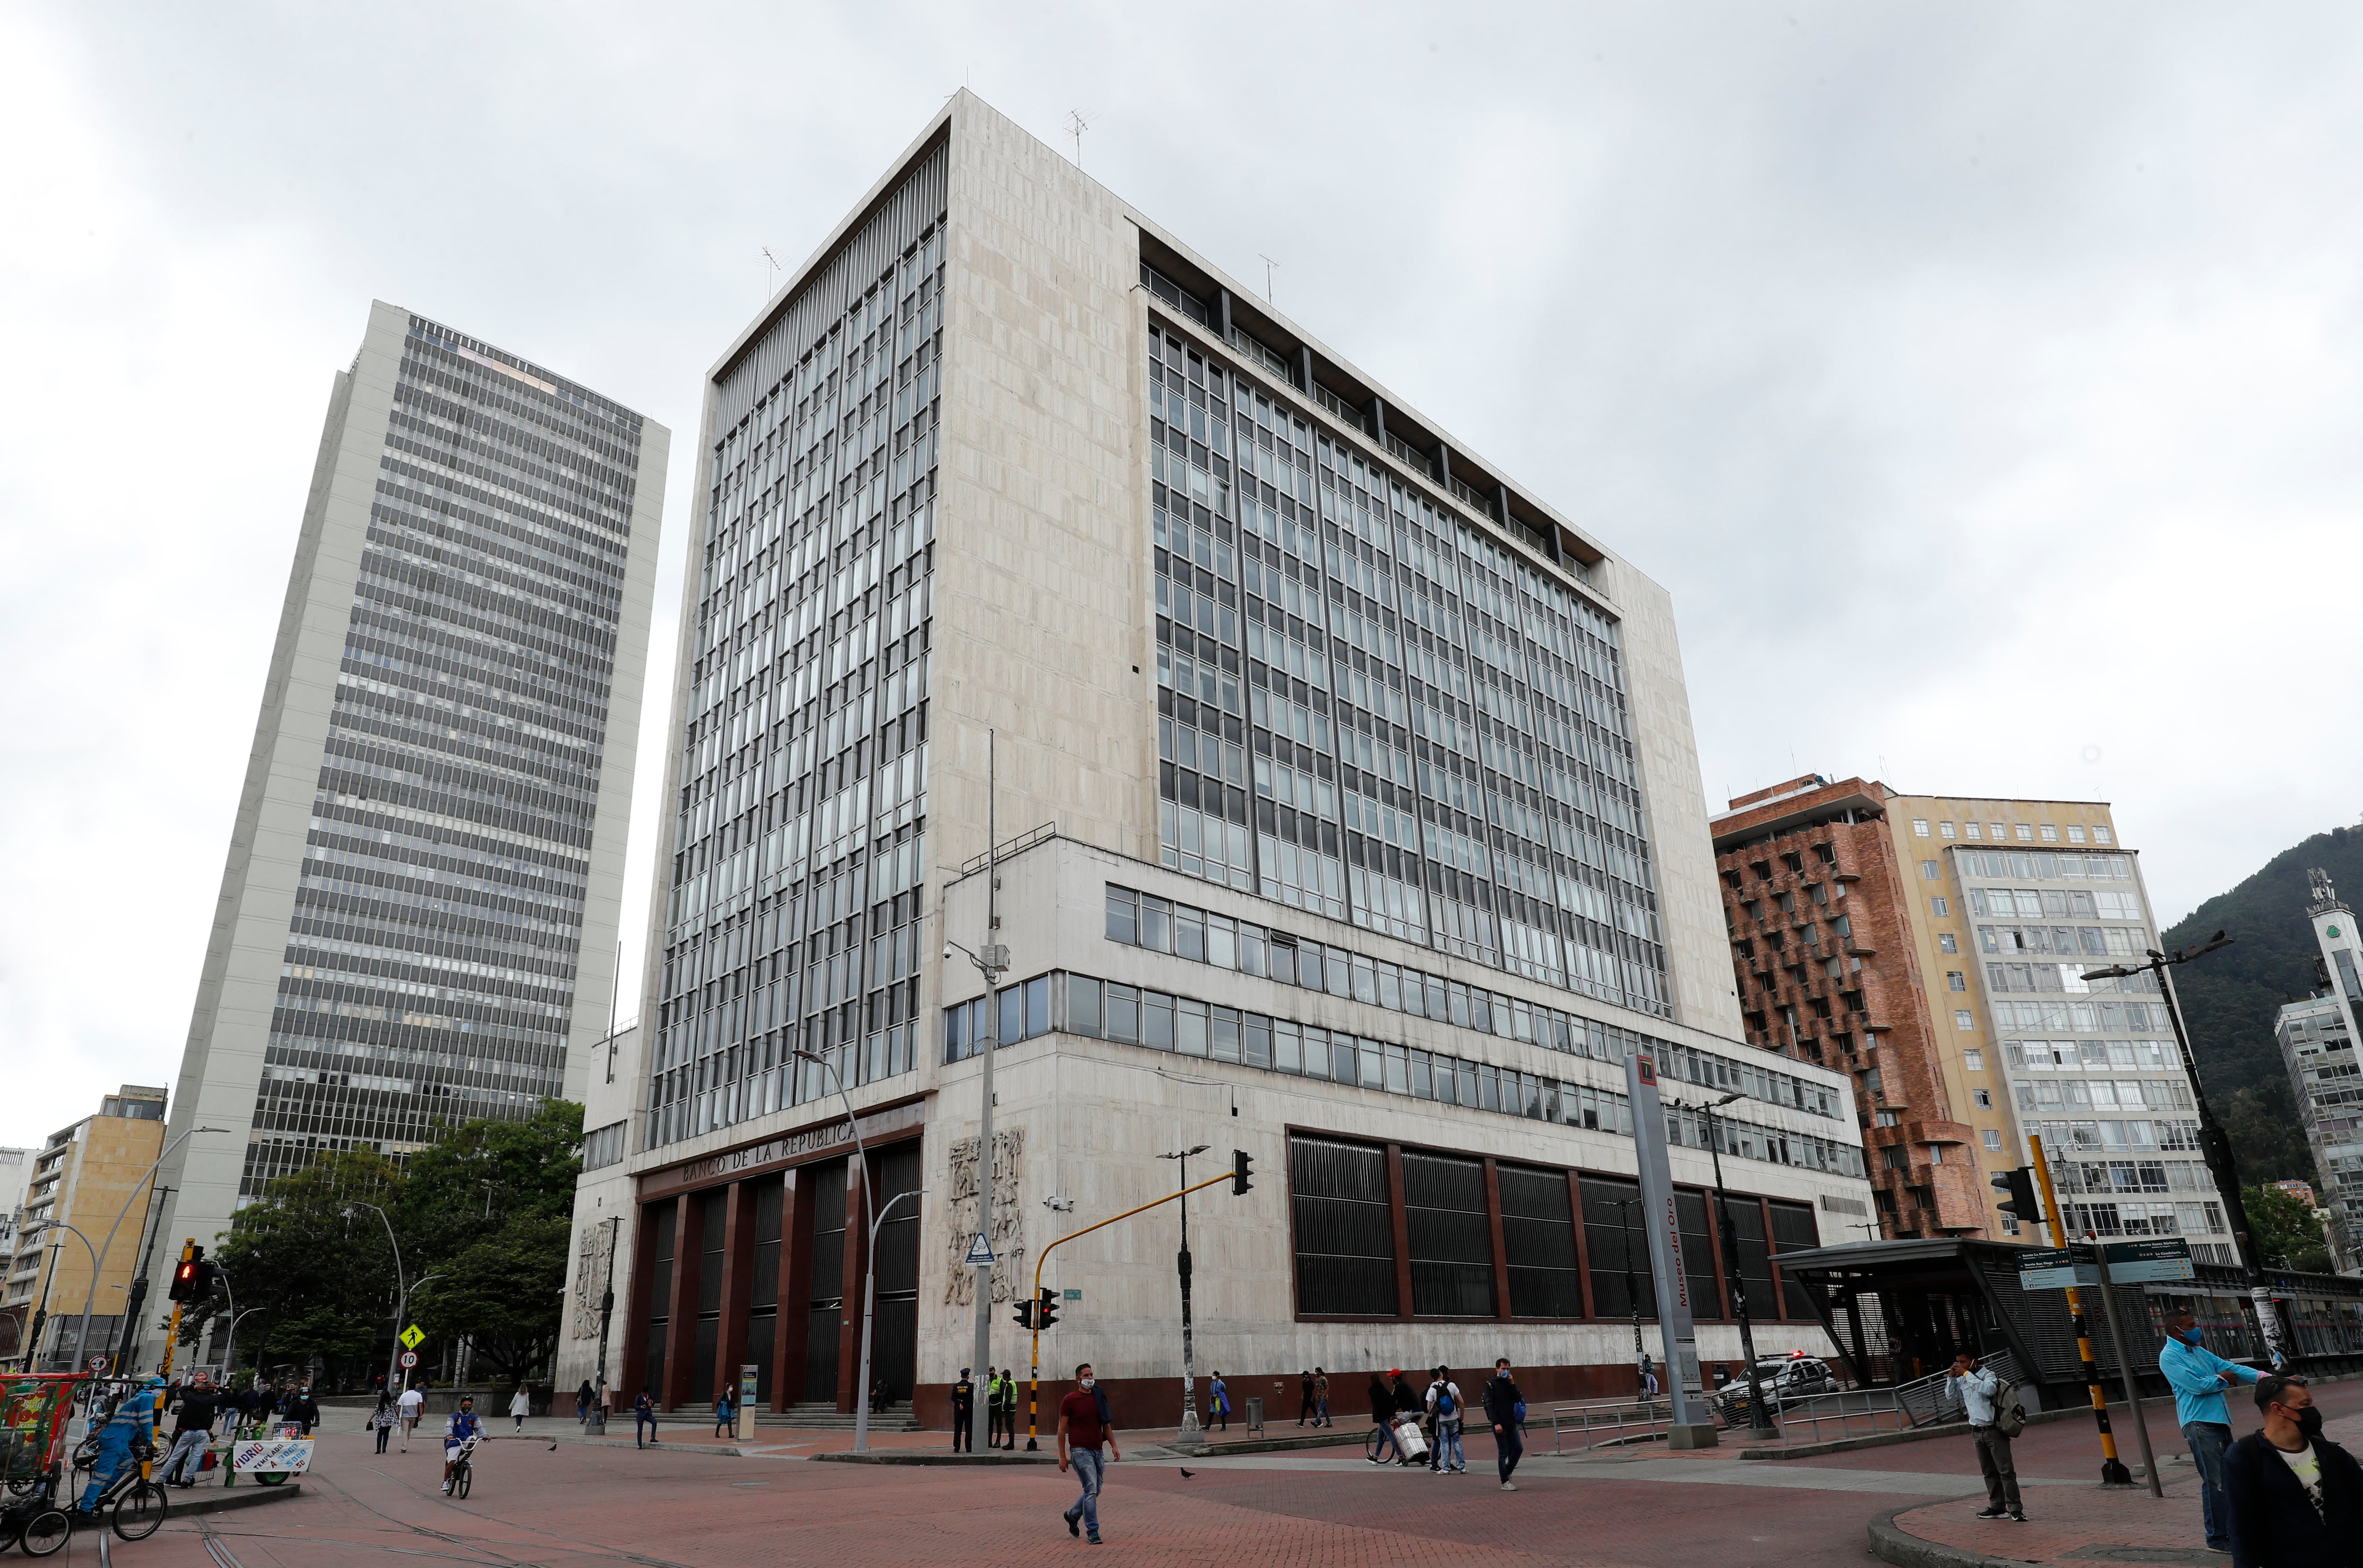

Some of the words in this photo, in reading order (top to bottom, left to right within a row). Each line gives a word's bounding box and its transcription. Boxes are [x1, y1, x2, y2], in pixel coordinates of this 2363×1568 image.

[683, 1157, 725, 1182] BANCO
[733, 1150, 748, 1169] DE
[756, 1144, 772, 1163] LA
[1670, 1232, 1679, 1253] del
[1675, 1258, 1687, 1307] Museo
[405, 1355, 414, 1364] 10
[233, 1442, 264, 1469] VIDRIO
[254, 1444, 284, 1470] TEMPLADO
[278, 1443, 299, 1462] 3000
[285, 1449, 307, 1467] 5000
